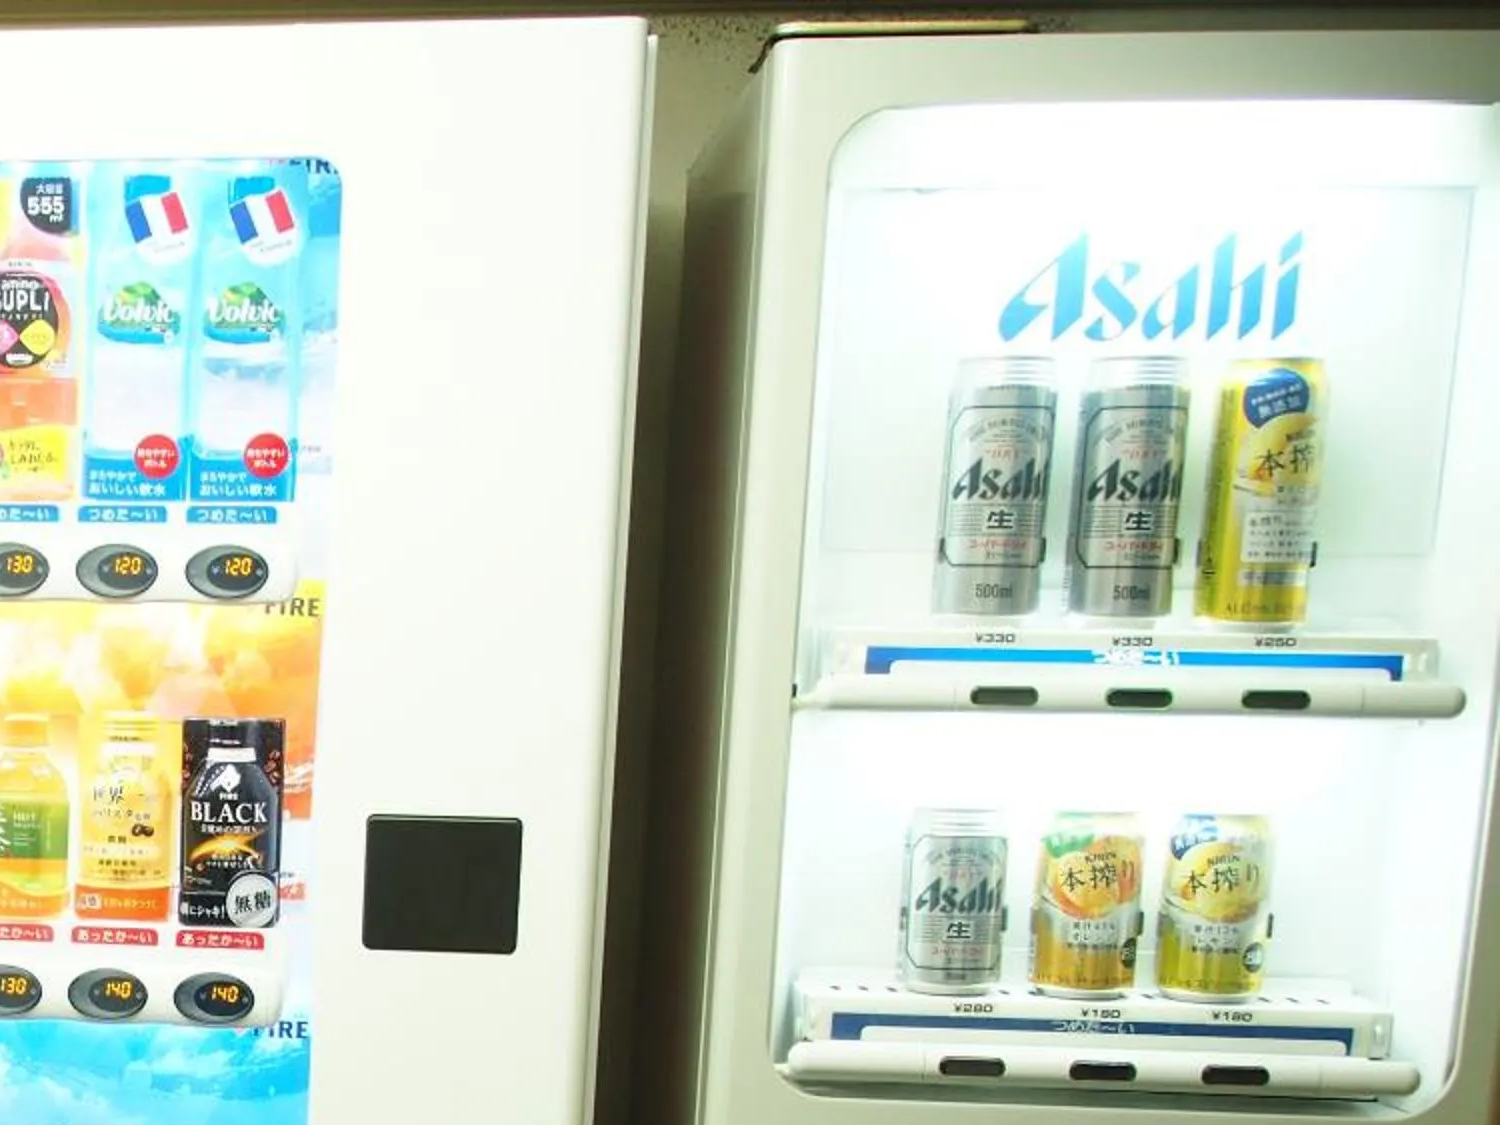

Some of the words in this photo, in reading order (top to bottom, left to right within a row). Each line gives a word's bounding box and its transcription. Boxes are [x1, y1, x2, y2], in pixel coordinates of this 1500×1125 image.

[998, 230, 1303, 342] Asahi
[986, 510, 1015, 529] 生
[1124, 511, 1152, 531] 生
[6, 555, 34, 573] 130
[114, 557, 141, 575] 120
[224, 557, 253, 575] 120
[190, 801, 268, 824] BLACK
[946, 921, 971, 939] 生
[0, 977, 27, 995] 130
[105, 981, 132, 998] 140
[211, 985, 239, 1003] 140
